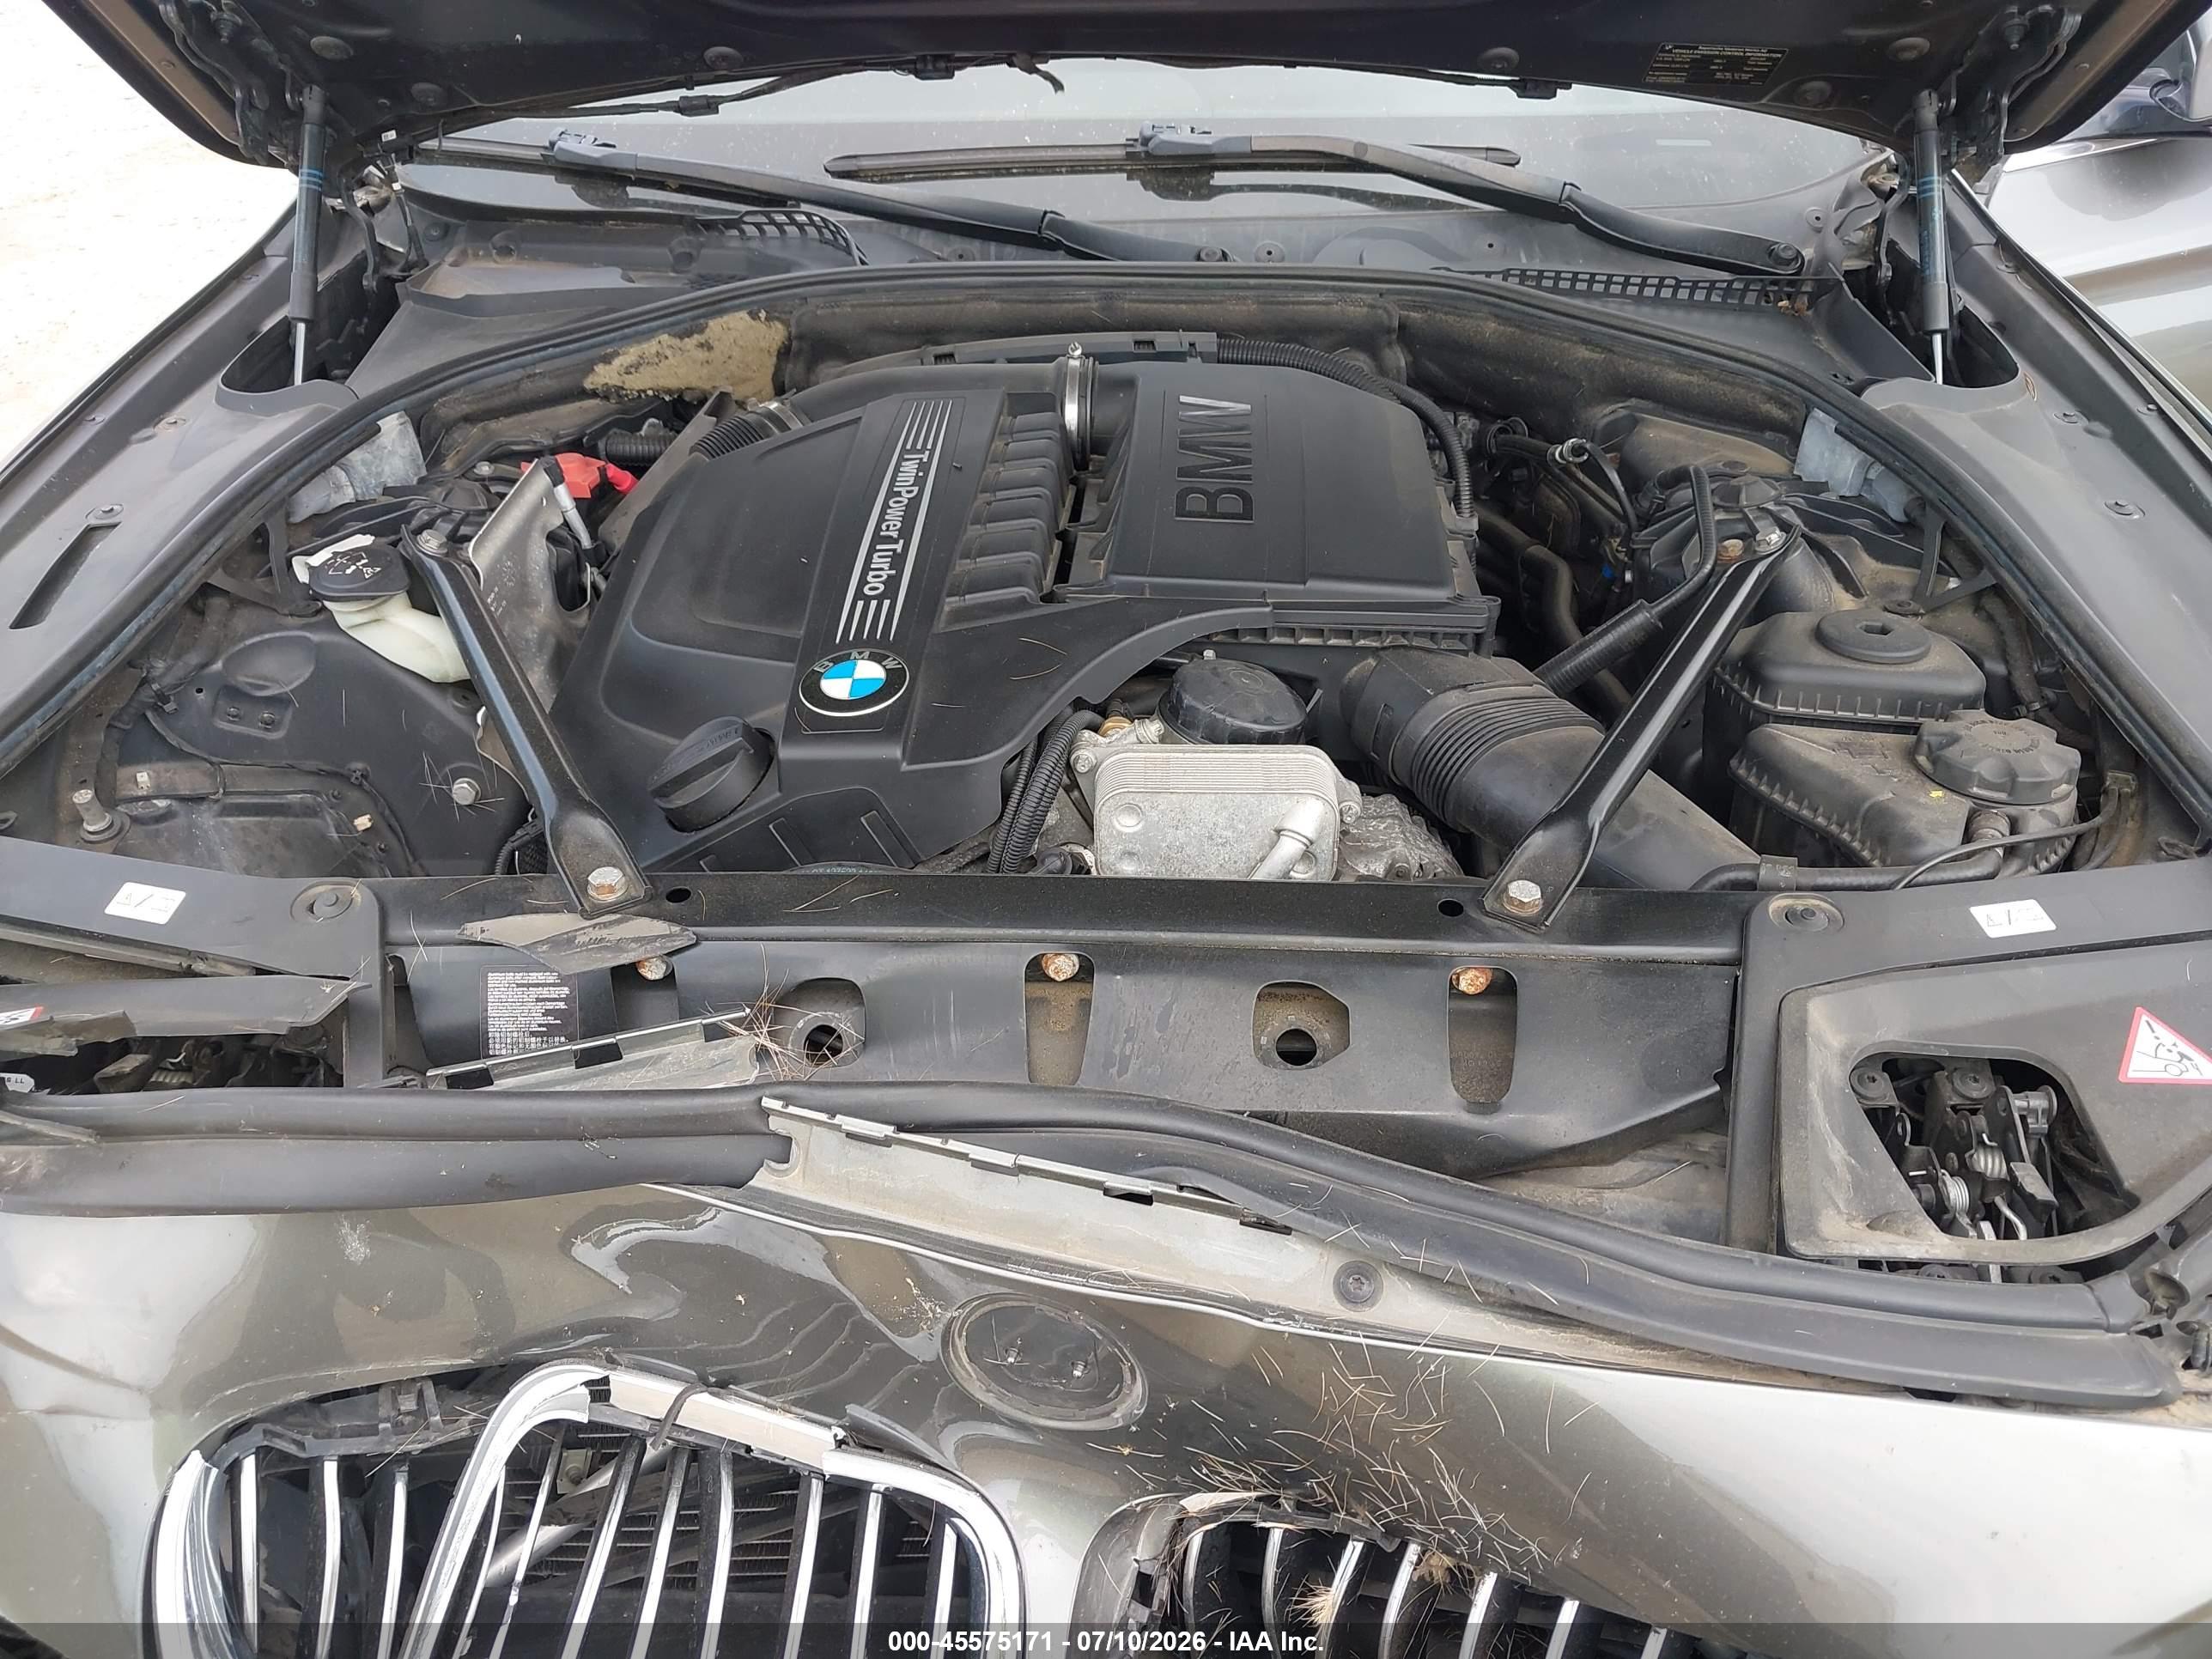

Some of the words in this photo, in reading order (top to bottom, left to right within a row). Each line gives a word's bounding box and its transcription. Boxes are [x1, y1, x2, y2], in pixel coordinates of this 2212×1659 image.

[879, 451, 930, 538] TwinPower
[1175, 395, 1255, 523] BMW
[863, 539, 904, 595] Turbo
[813, 651, 903, 674] BMW
